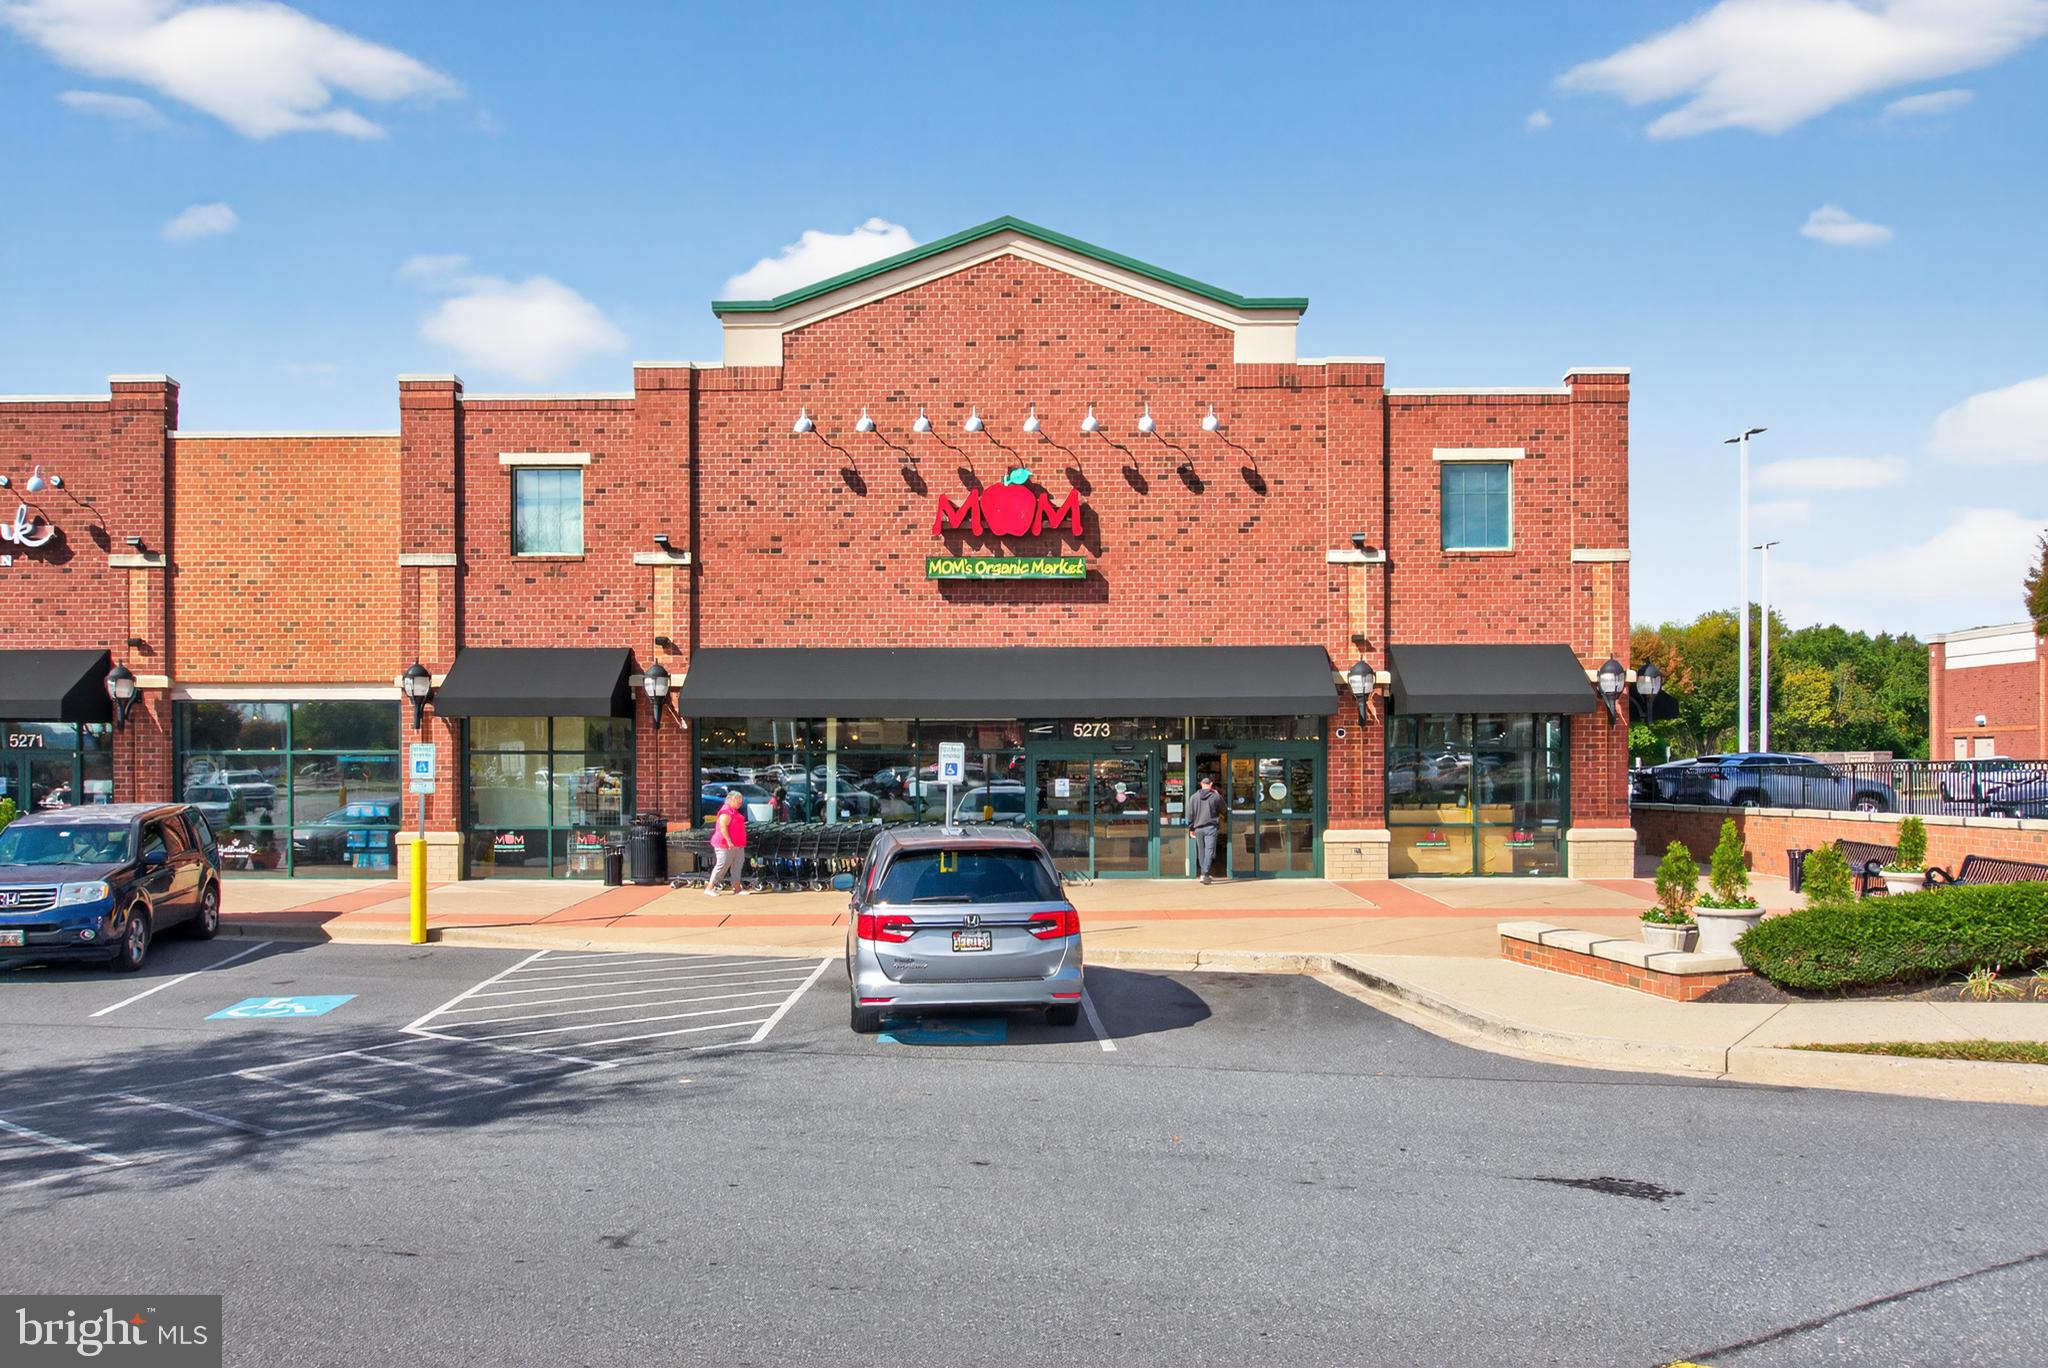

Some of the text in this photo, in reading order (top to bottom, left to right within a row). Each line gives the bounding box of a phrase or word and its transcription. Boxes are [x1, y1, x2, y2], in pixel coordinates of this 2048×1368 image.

[932, 483, 1083, 537] MOM
[928, 558, 1084, 576] MOM's Organic Market
[1073, 723, 1111, 737] 5273
[9, 734, 43, 748] 5271
